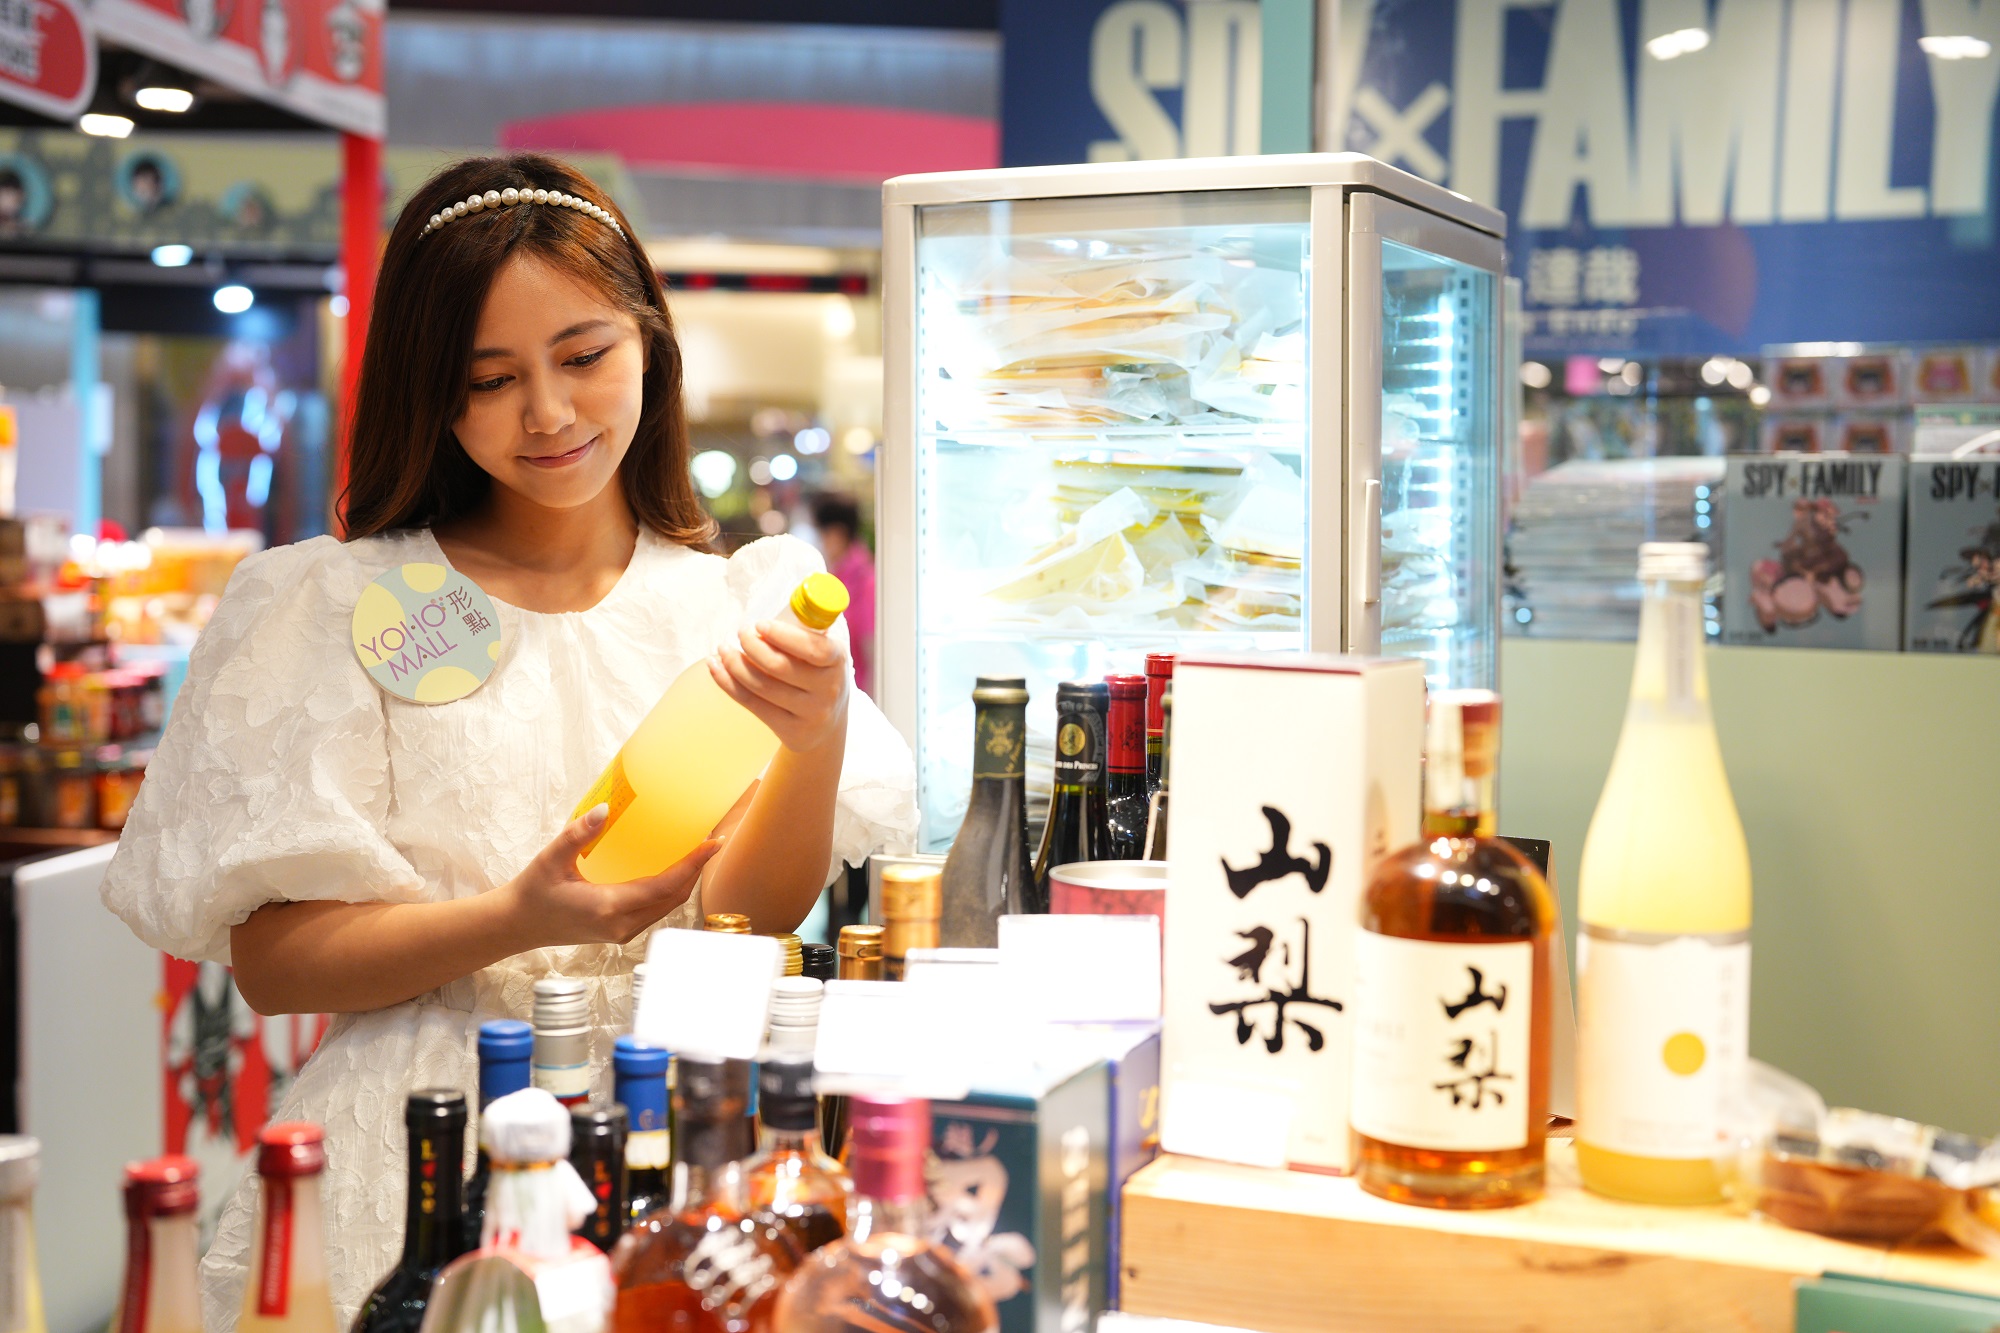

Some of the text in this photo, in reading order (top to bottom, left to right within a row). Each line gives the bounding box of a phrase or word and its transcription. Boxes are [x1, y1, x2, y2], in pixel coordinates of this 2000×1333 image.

[1452, 0, 2000, 228] FAMILY
[1743, 461, 1882, 499] SPY FAMILY
[1930, 463, 1979, 503] SPY
[446, 586, 491, 636] 形點
[387, 630, 458, 682] MALL
[1209, 805, 1343, 1053] 山梨
[1434, 966, 1513, 1109] 山梨
